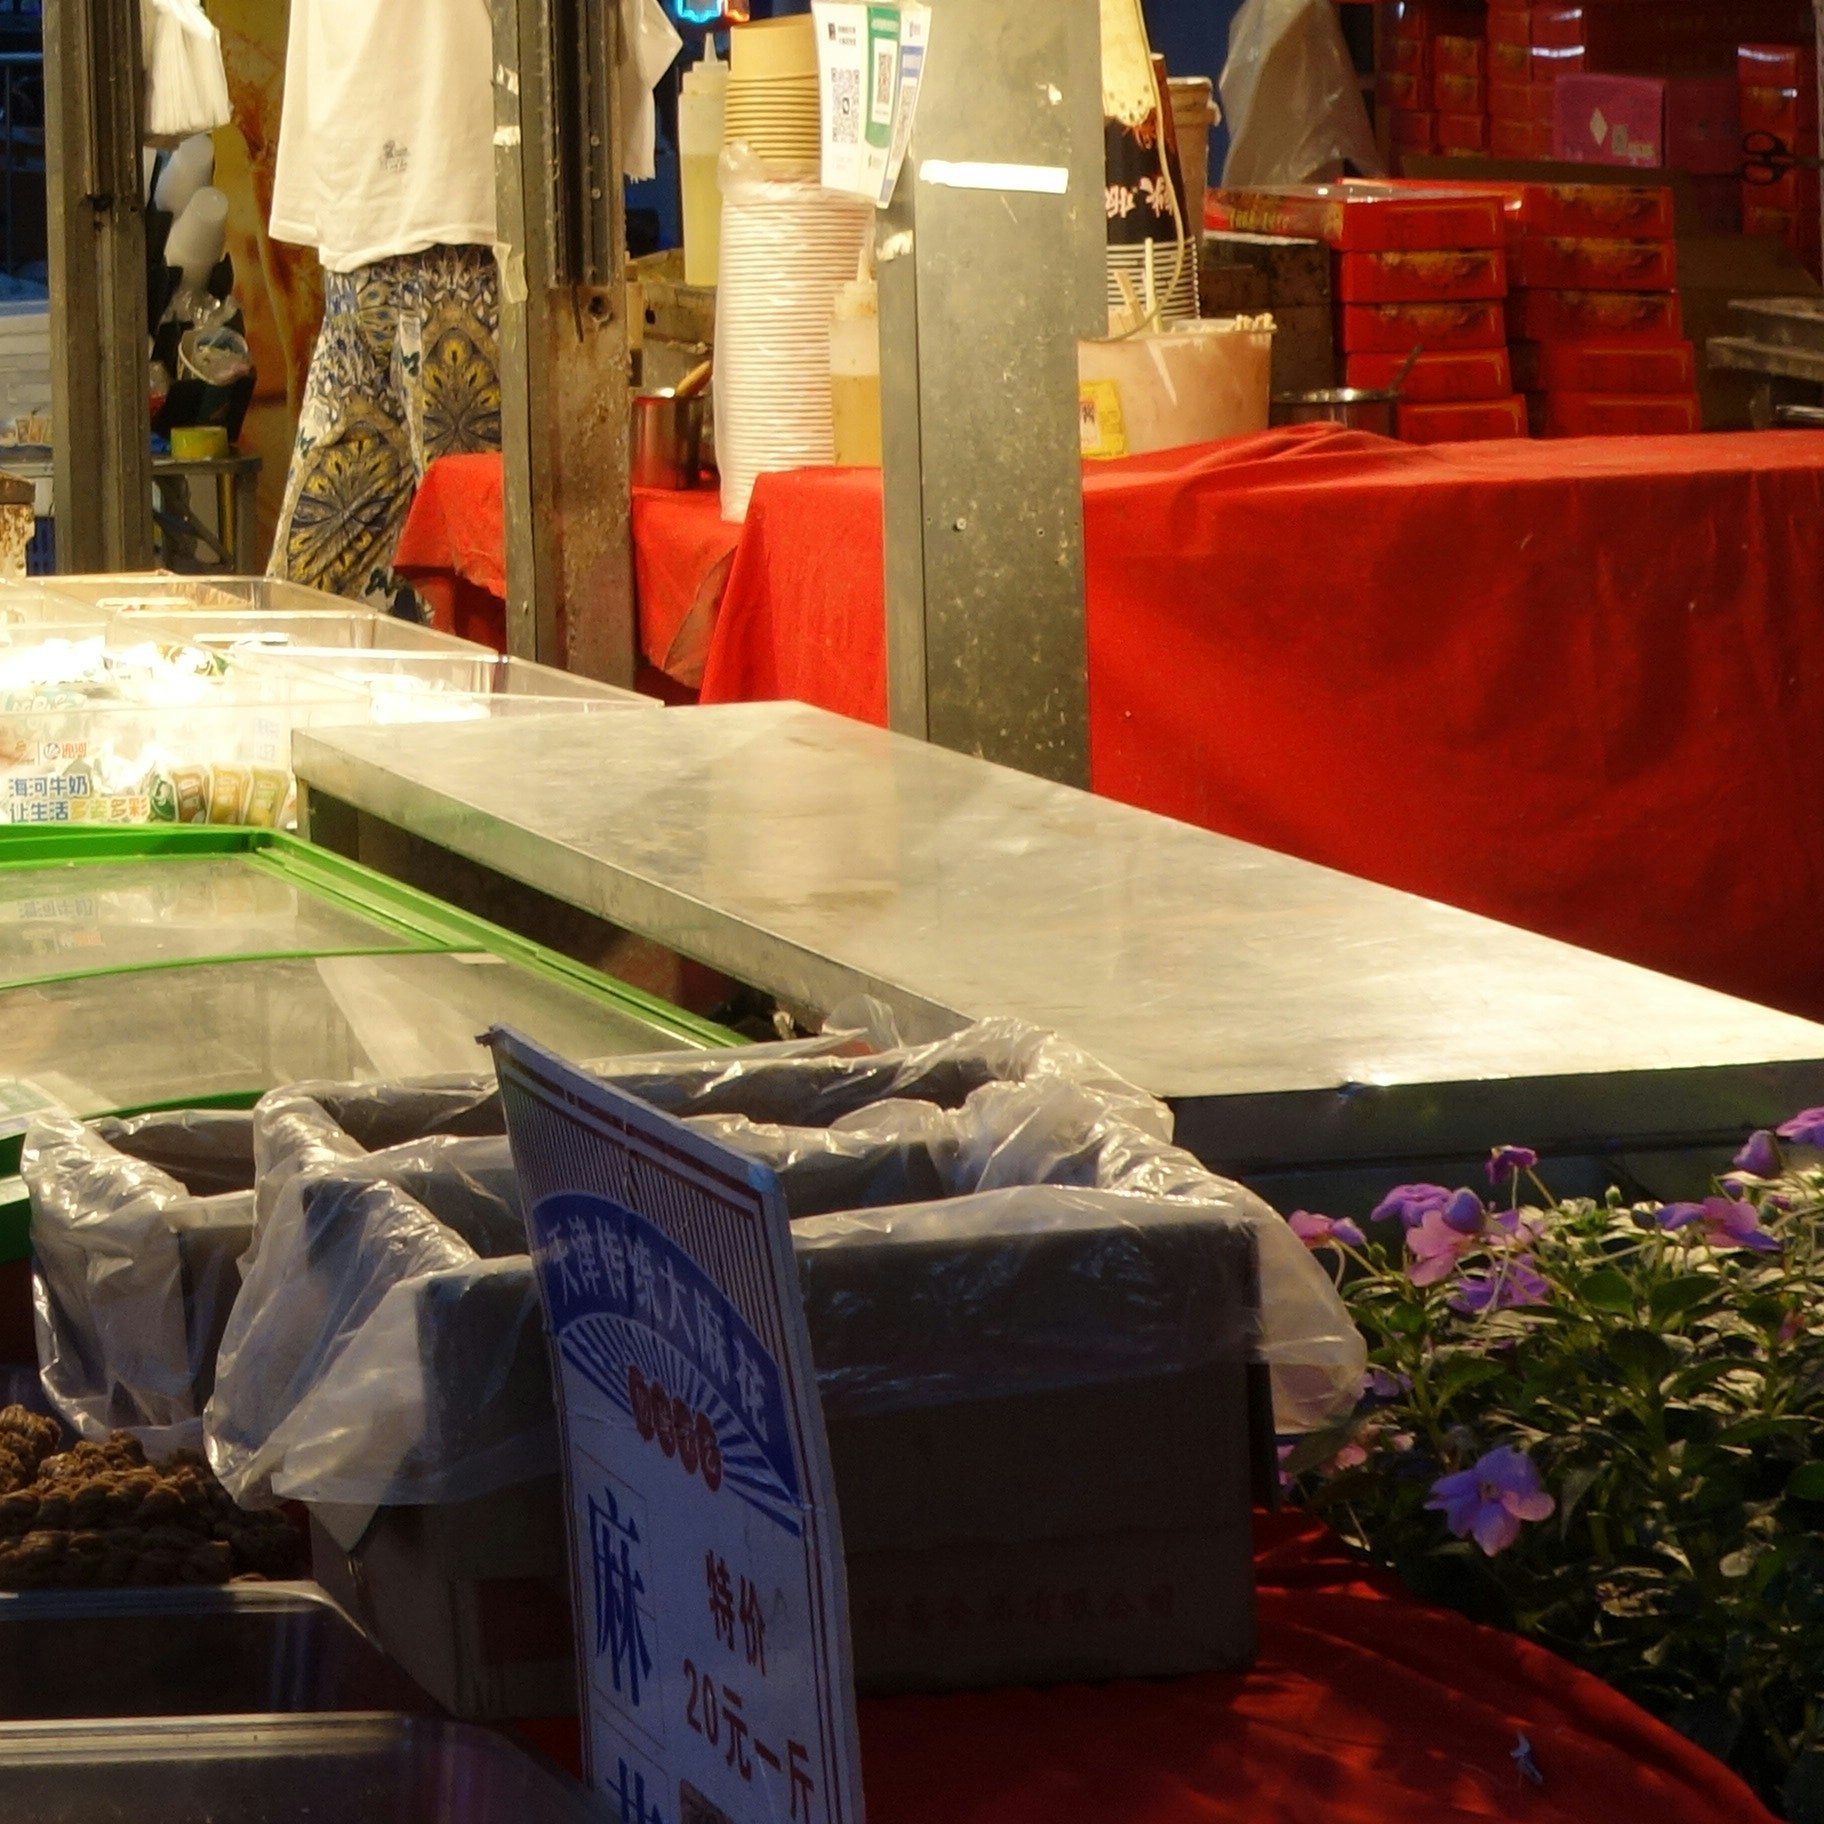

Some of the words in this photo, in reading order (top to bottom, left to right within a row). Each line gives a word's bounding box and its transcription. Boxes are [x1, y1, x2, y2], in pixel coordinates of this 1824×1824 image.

[9, 776, 89, 798] 海河牛奶
[10, 797, 149, 823] 让生活多姿多彩
[705, 1549, 766, 1677] 特价
[683, 1658, 815, 1824] 20元一斤
